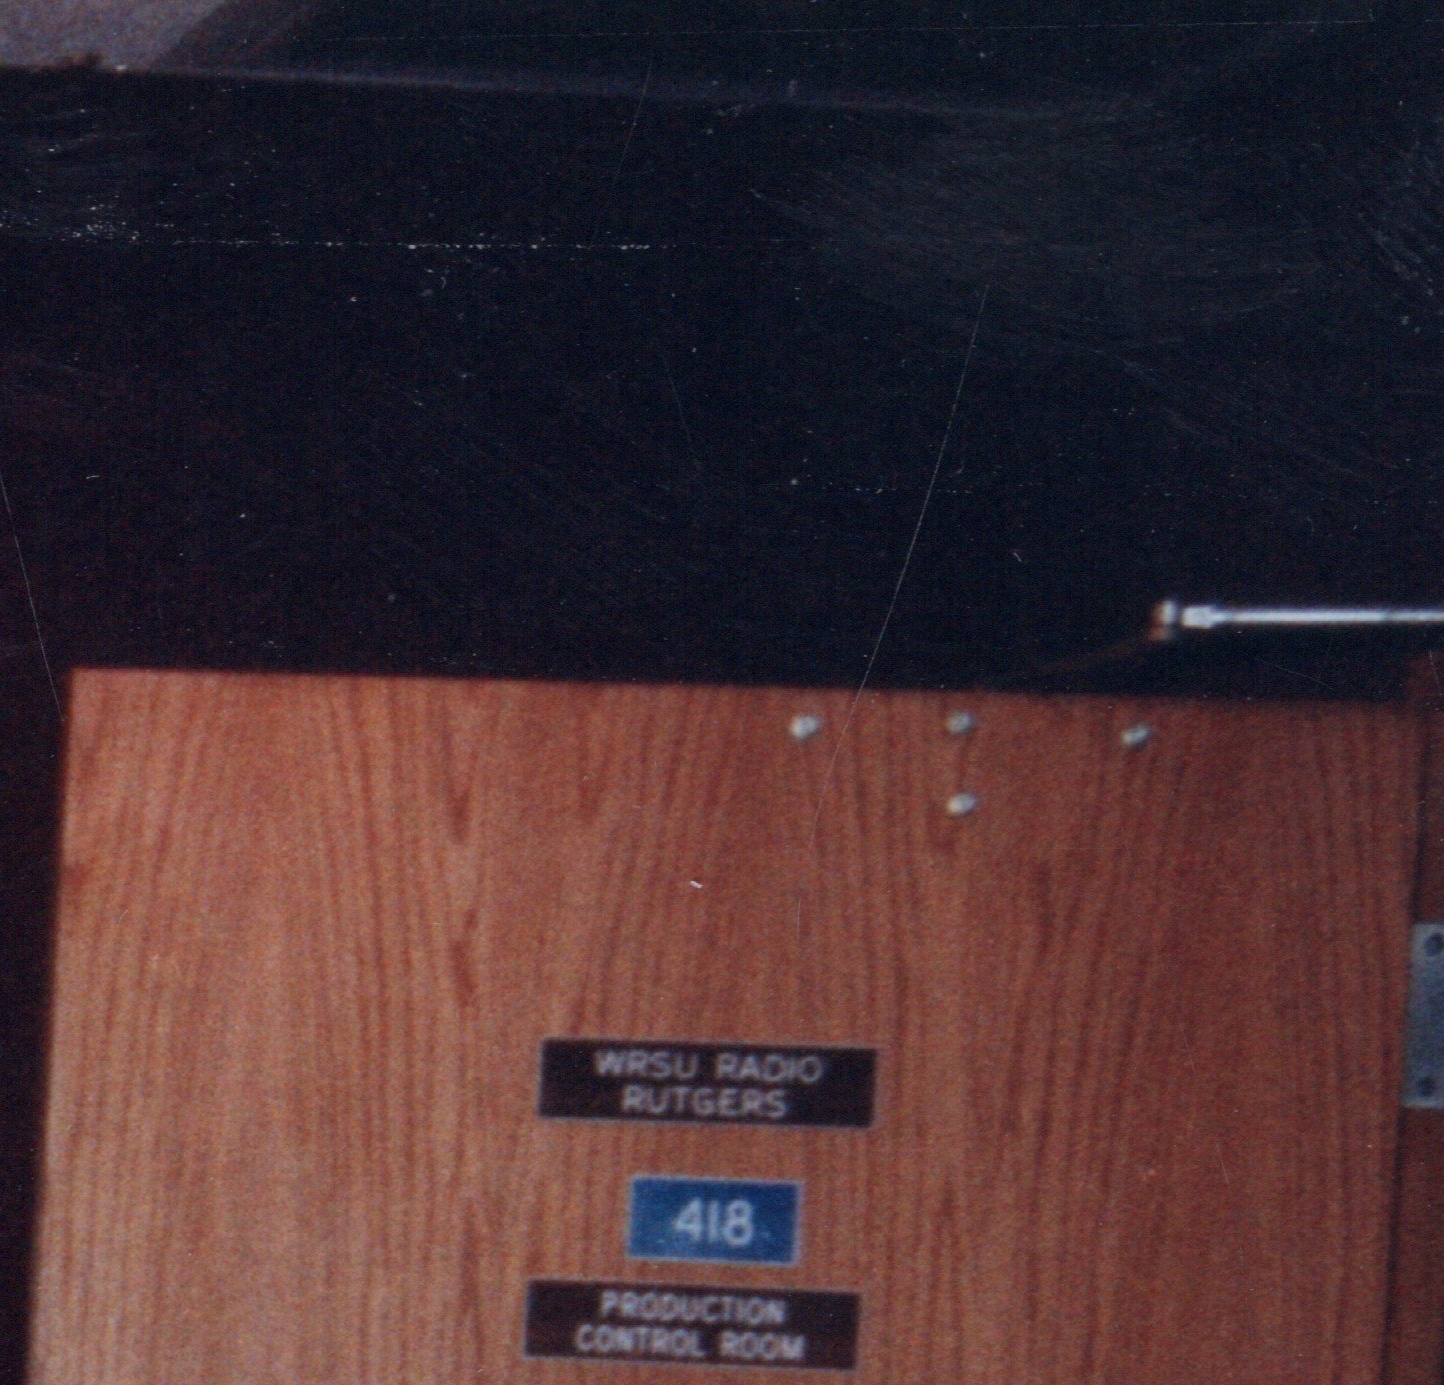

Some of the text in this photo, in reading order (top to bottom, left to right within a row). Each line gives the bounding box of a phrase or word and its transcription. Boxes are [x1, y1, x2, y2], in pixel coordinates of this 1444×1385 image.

[595, 1050, 823, 1083] WRSU RADIO
[621, 1085, 787, 1118] RUTGERS
[673, 1198, 754, 1247] 418
[601, 1291, 785, 1324] PRODUCTION
[575, 1325, 806, 1361] CONTROL ROOM
